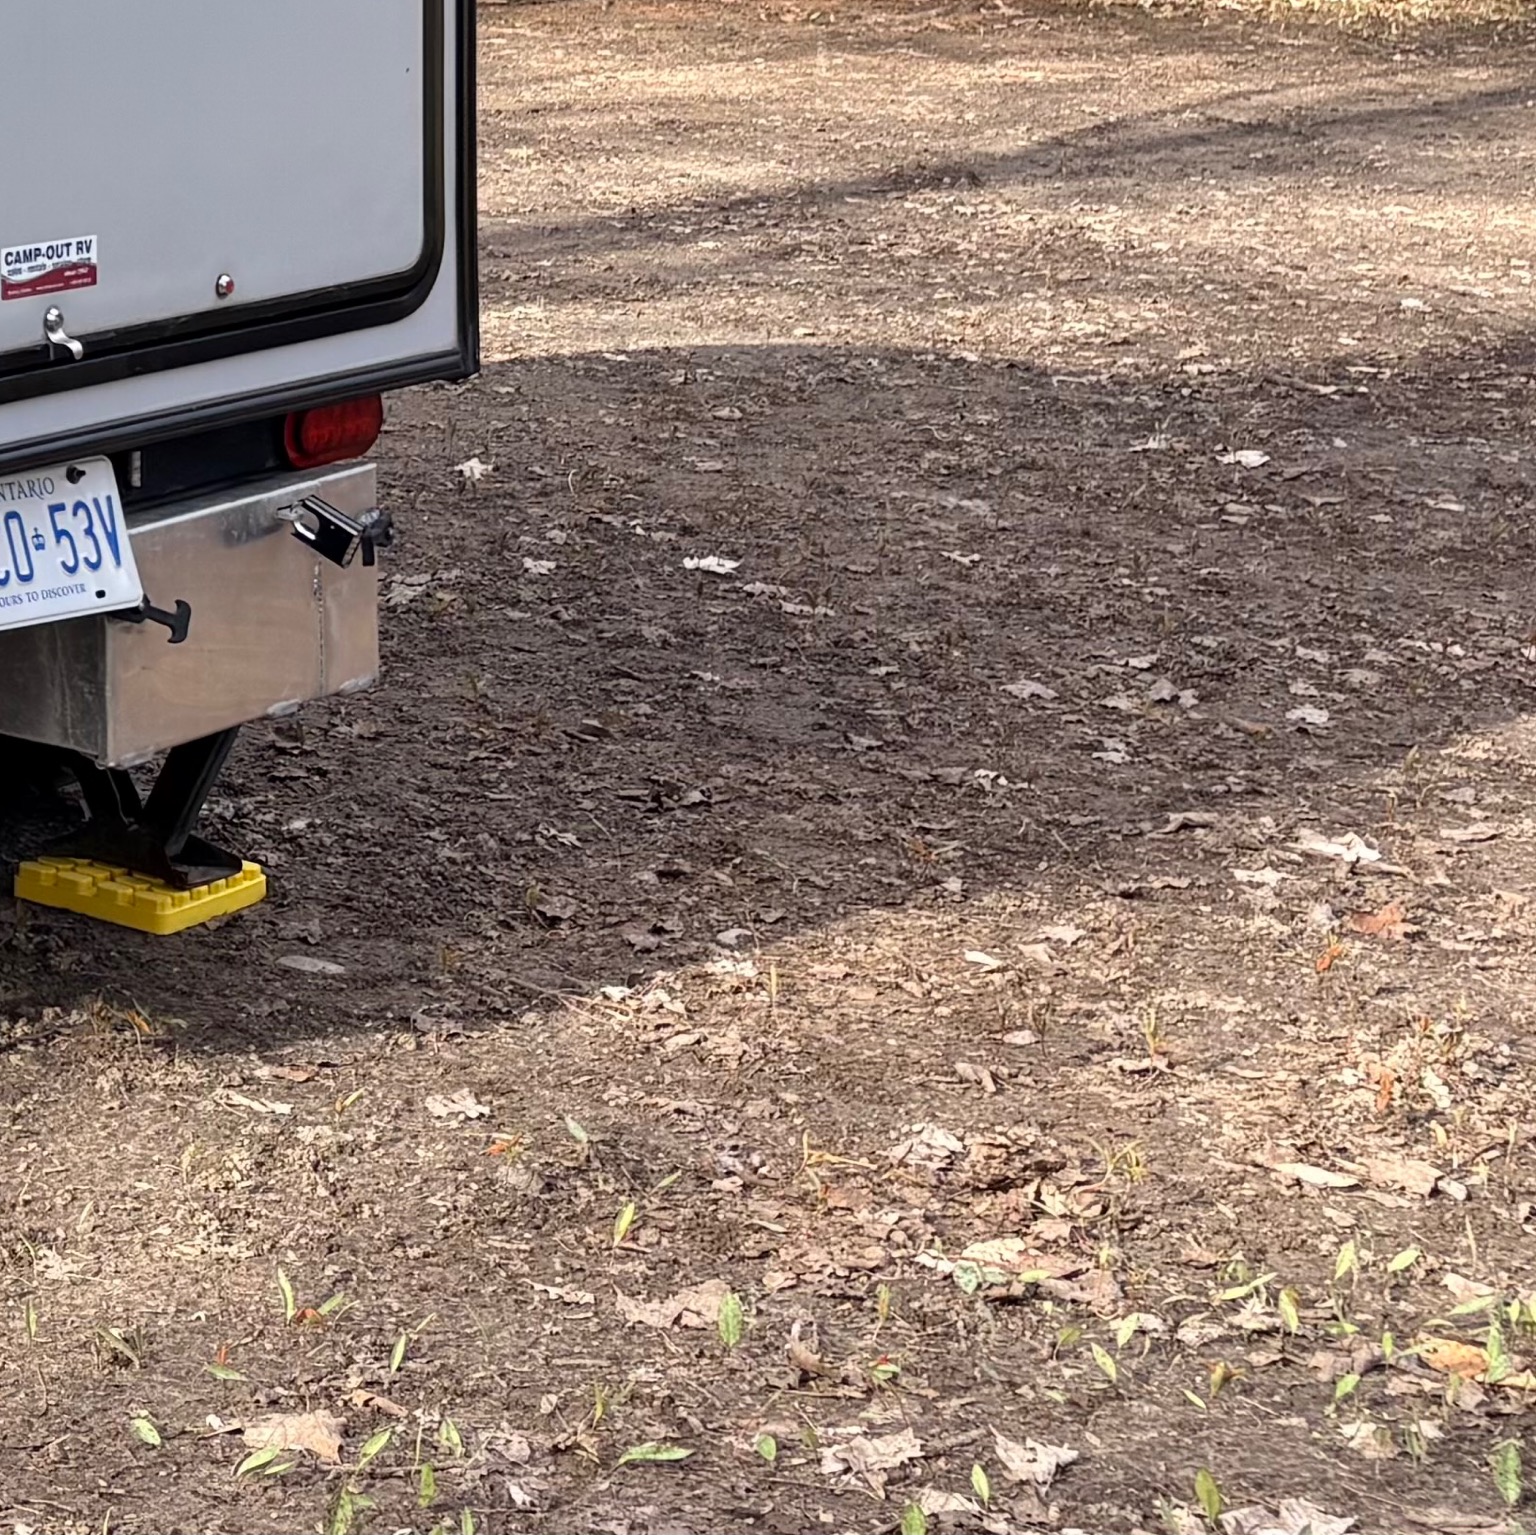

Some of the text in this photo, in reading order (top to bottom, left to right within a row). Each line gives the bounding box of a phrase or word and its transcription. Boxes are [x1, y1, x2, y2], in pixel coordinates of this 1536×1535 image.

[4, 242, 73, 267] CAMP-OUT
[76, 239, 93, 256] RV
[47, 495, 122, 574] 53V
[25, 591, 39, 604] TO
[41, 583, 87, 601] DISCOVER
